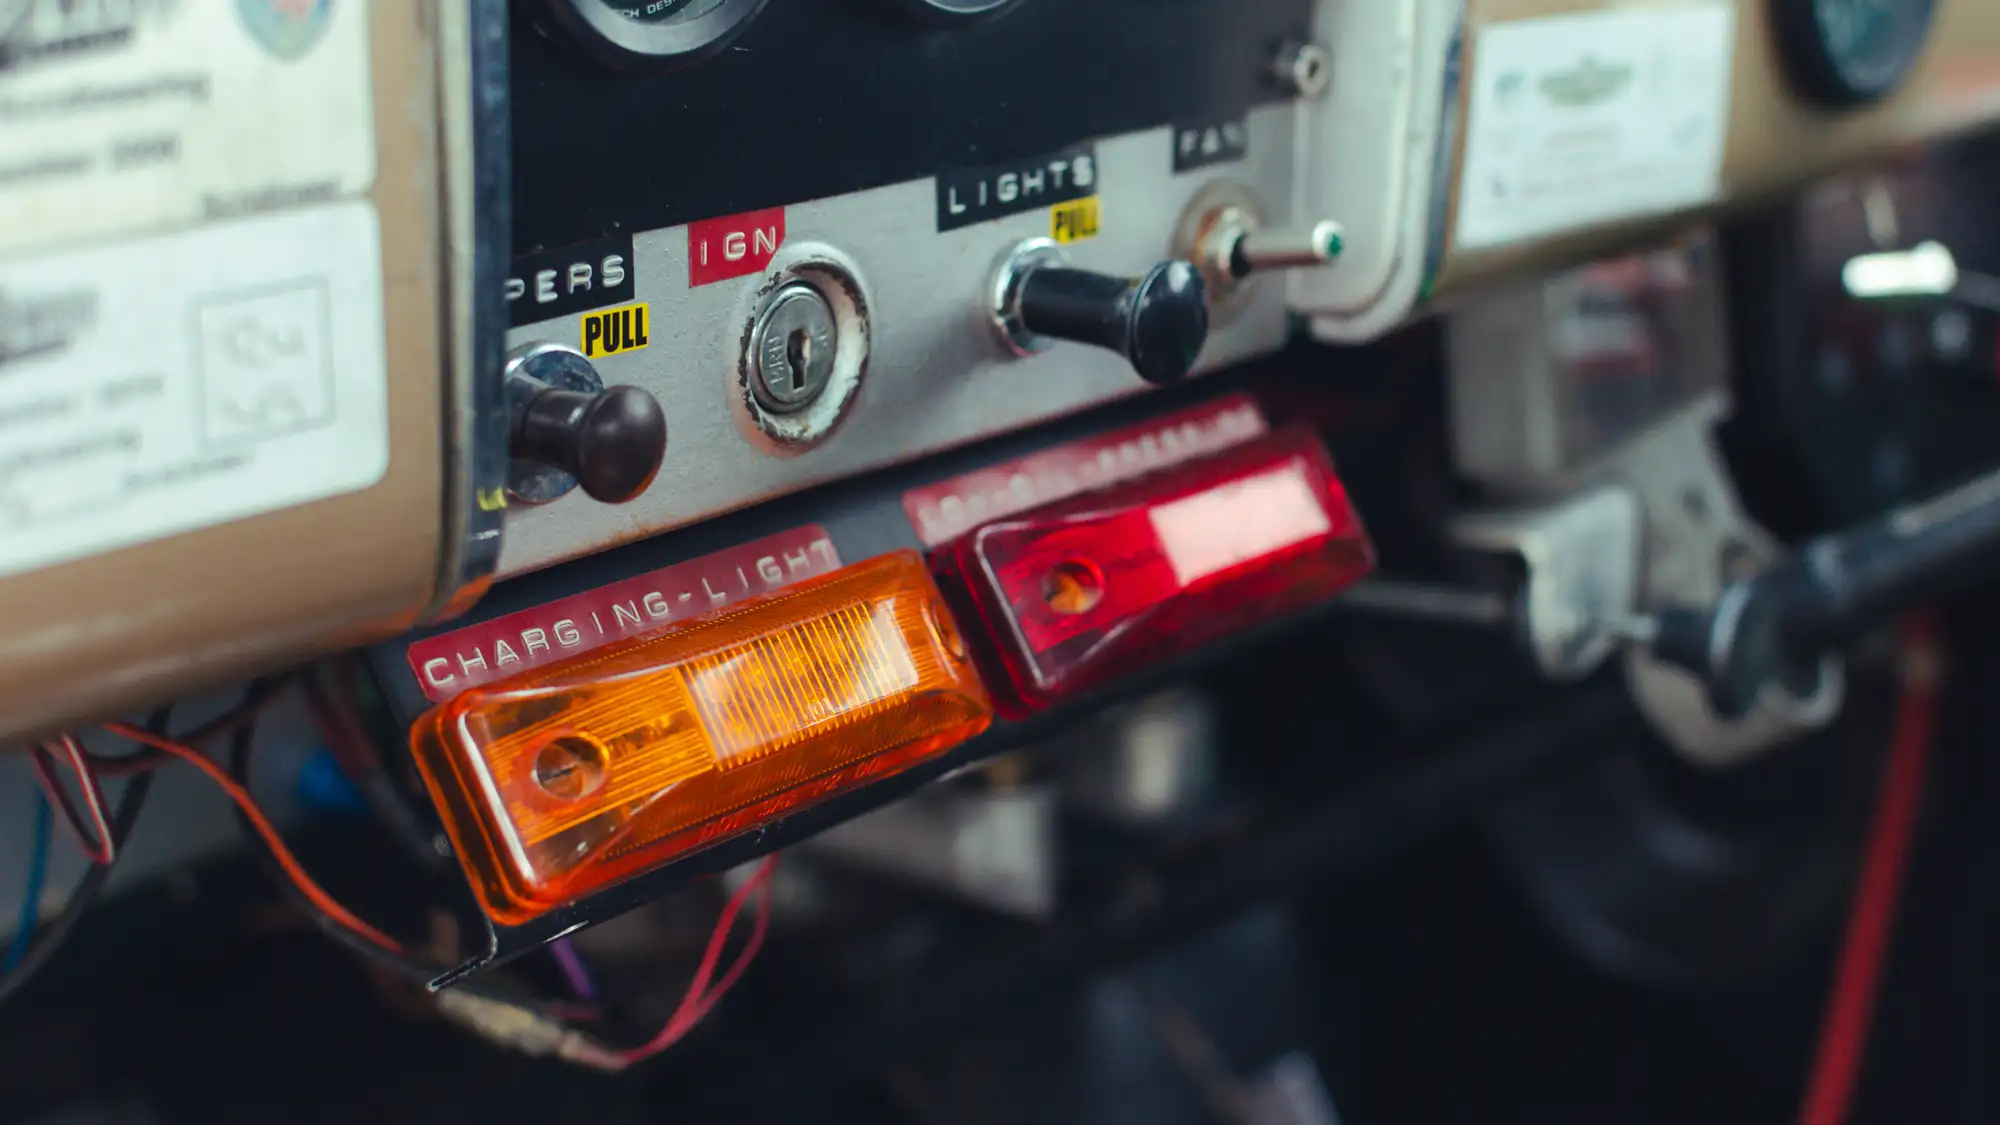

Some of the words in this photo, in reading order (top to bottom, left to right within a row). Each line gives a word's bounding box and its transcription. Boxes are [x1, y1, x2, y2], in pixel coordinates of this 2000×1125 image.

[646, 0, 676, 14] DES
[948, 156, 1093, 214] LIGHTS
[701, 226, 776, 266] IGN
[1054, 206, 1097, 241] PULL
[585, 307, 647, 357] PULL
[424, 539, 832, 688] CHARGING-LIGHT
